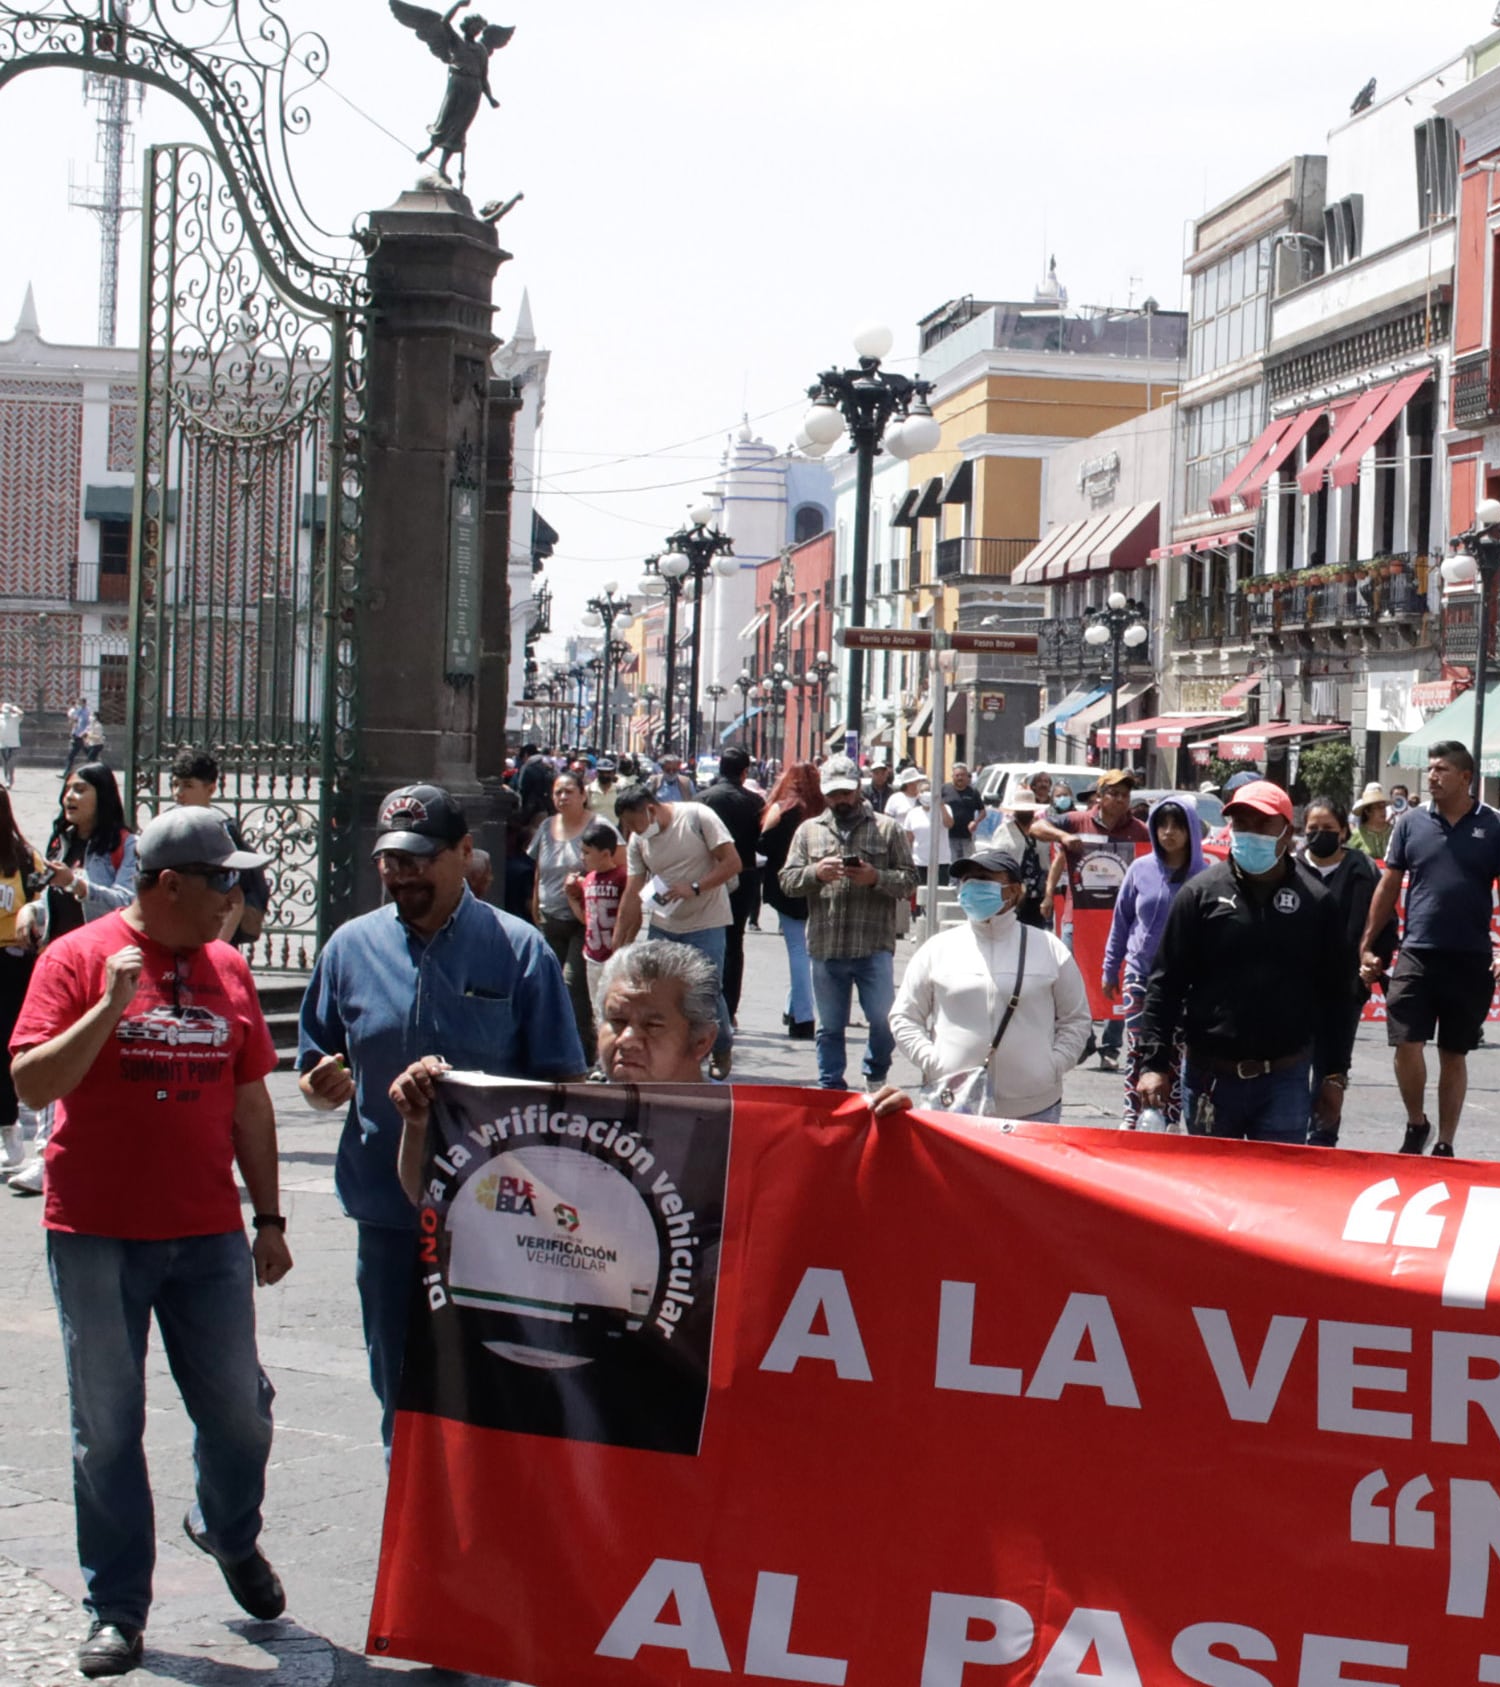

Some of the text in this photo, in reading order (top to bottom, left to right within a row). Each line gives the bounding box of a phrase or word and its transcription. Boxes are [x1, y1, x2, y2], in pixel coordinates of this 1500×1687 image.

[882, 636, 891, 645] de
[973, 638, 1016, 649] Paseo Bravo
[119, 1058, 184, 1082] SUMMIT
[499, 1175, 537, 1200] PUE
[496, 1195, 537, 1218] BLA
[420, 1104, 699, 1340] Di NO a la verificación vehicular
[516, 1234, 618, 1263] VERIFICACIÓN
[525, 1249, 607, 1273] VEHICULAR
[759, 1267, 873, 1382] A
[935, 1280, 1142, 1410] LA
[593, 1557, 849, 1686] AL
